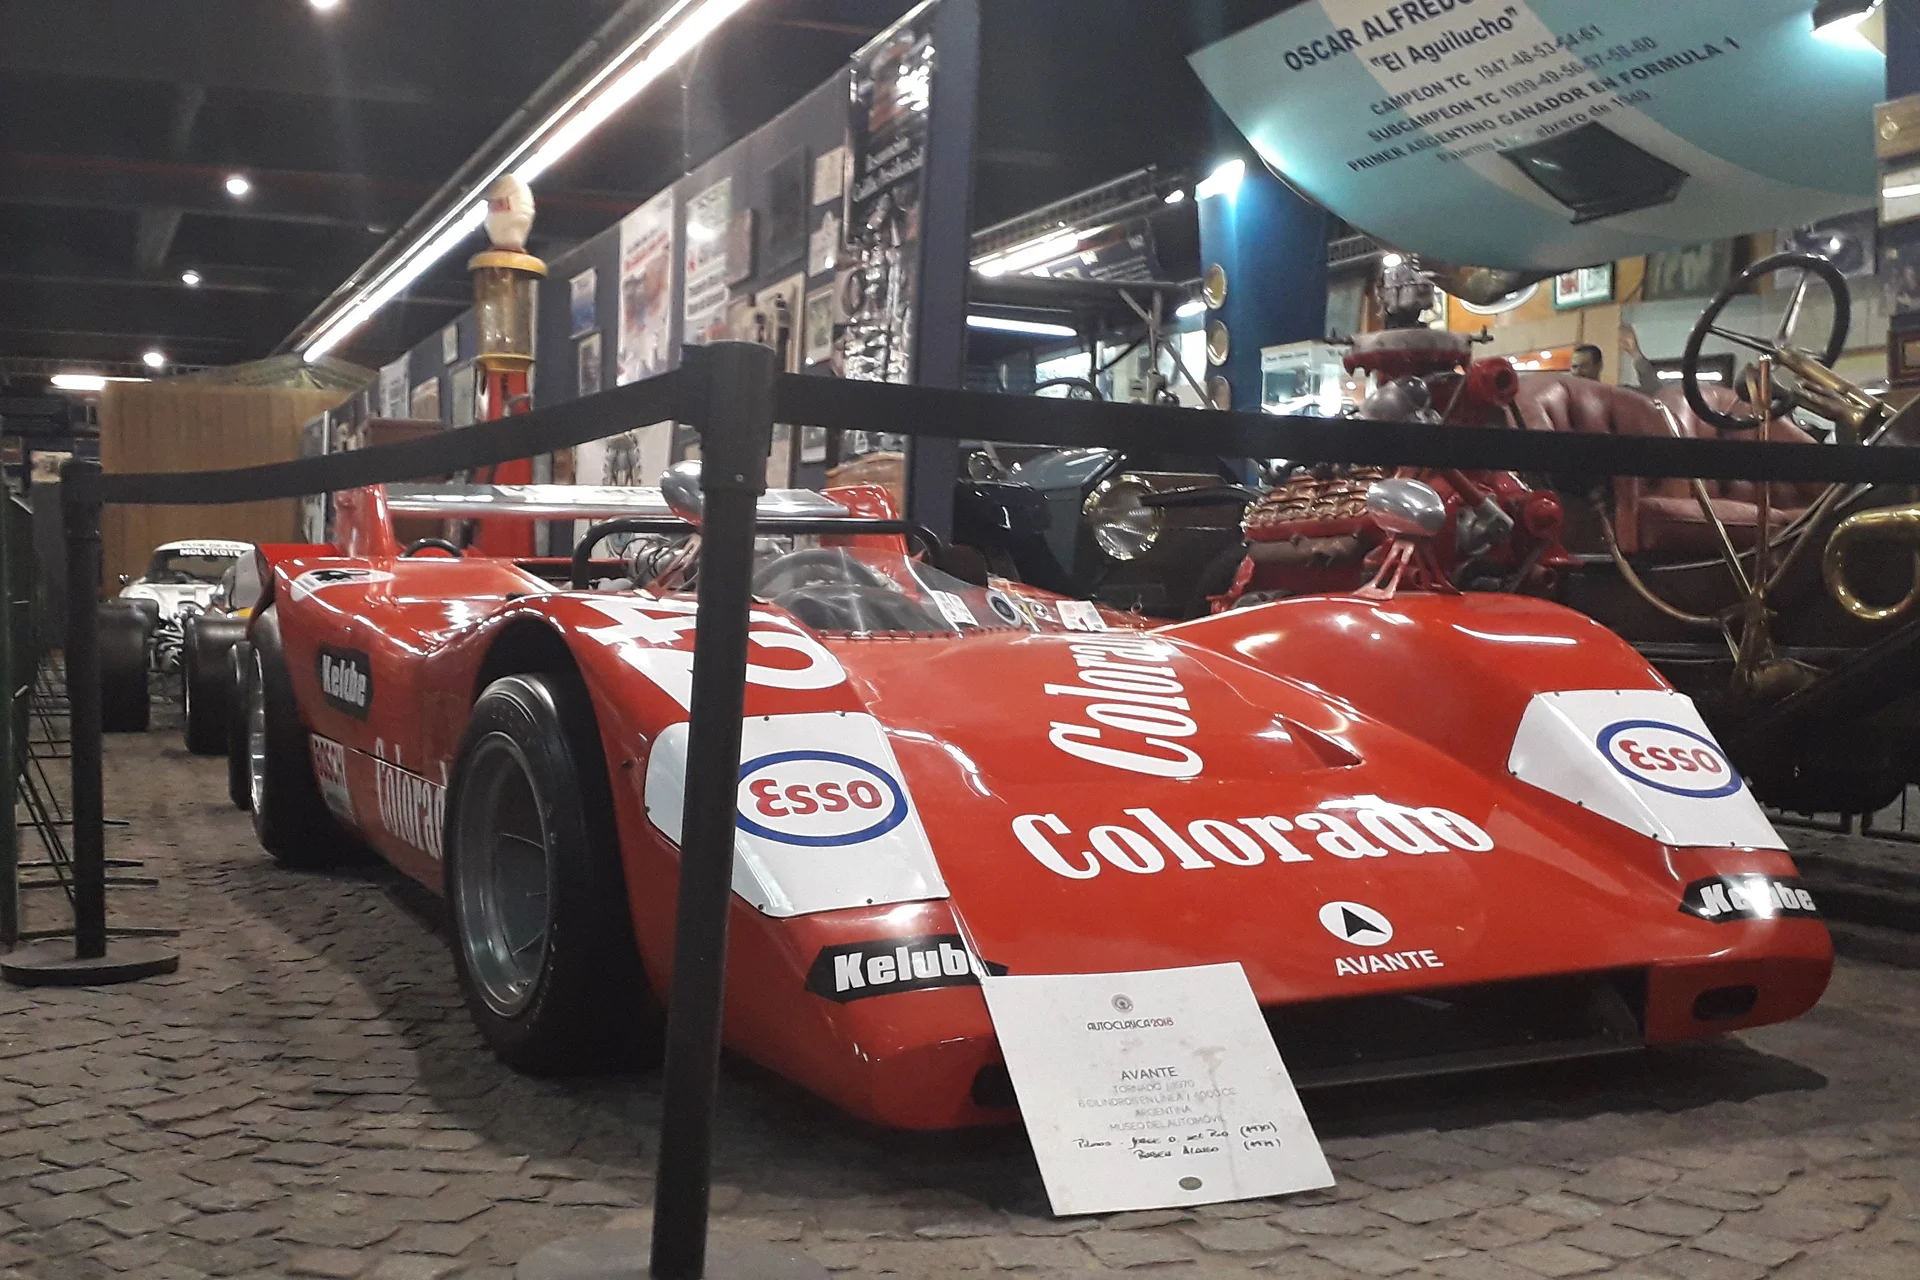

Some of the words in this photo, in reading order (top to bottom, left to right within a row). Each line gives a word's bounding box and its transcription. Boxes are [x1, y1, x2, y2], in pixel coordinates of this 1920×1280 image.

[1284, 28, 1362, 71] OSCAR
[1406, 6, 1518, 64] Aguilucho"
[1347, 147, 1408, 172] PRIMER
[1406, 118, 1497, 152] ARGENTINO
[1499, 87, 1590, 126] GANADOR
[1588, 76, 1619, 95] EN
[1618, 43, 1723, 84] FORMULA
[1724, 35, 1741, 49] 1
[1370, 81, 1448, 115] CAMPEON
[1445, 73, 1471, 89] TC
[1588, 103, 1612, 117] de
[1368, 100, 1476, 142] SUBCAMPEON
[1474, 92, 1501, 107] TC
[179, 547, 241, 558] MOLYKOTE
[1012, 794, 1494, 880] Colorado
[1700, 882, 1816, 916] Keube
[834, 942, 976, 992] Kelub
[1335, 950, 1444, 976] AVANTE
[1113, 1082, 1162, 1094] TORNADO
[1121, 1066, 1178, 1081] AVANTE
[1109, 1121, 1145, 1132] MUSEO
[1134, 1105, 1192, 1117] ARGENTINA
